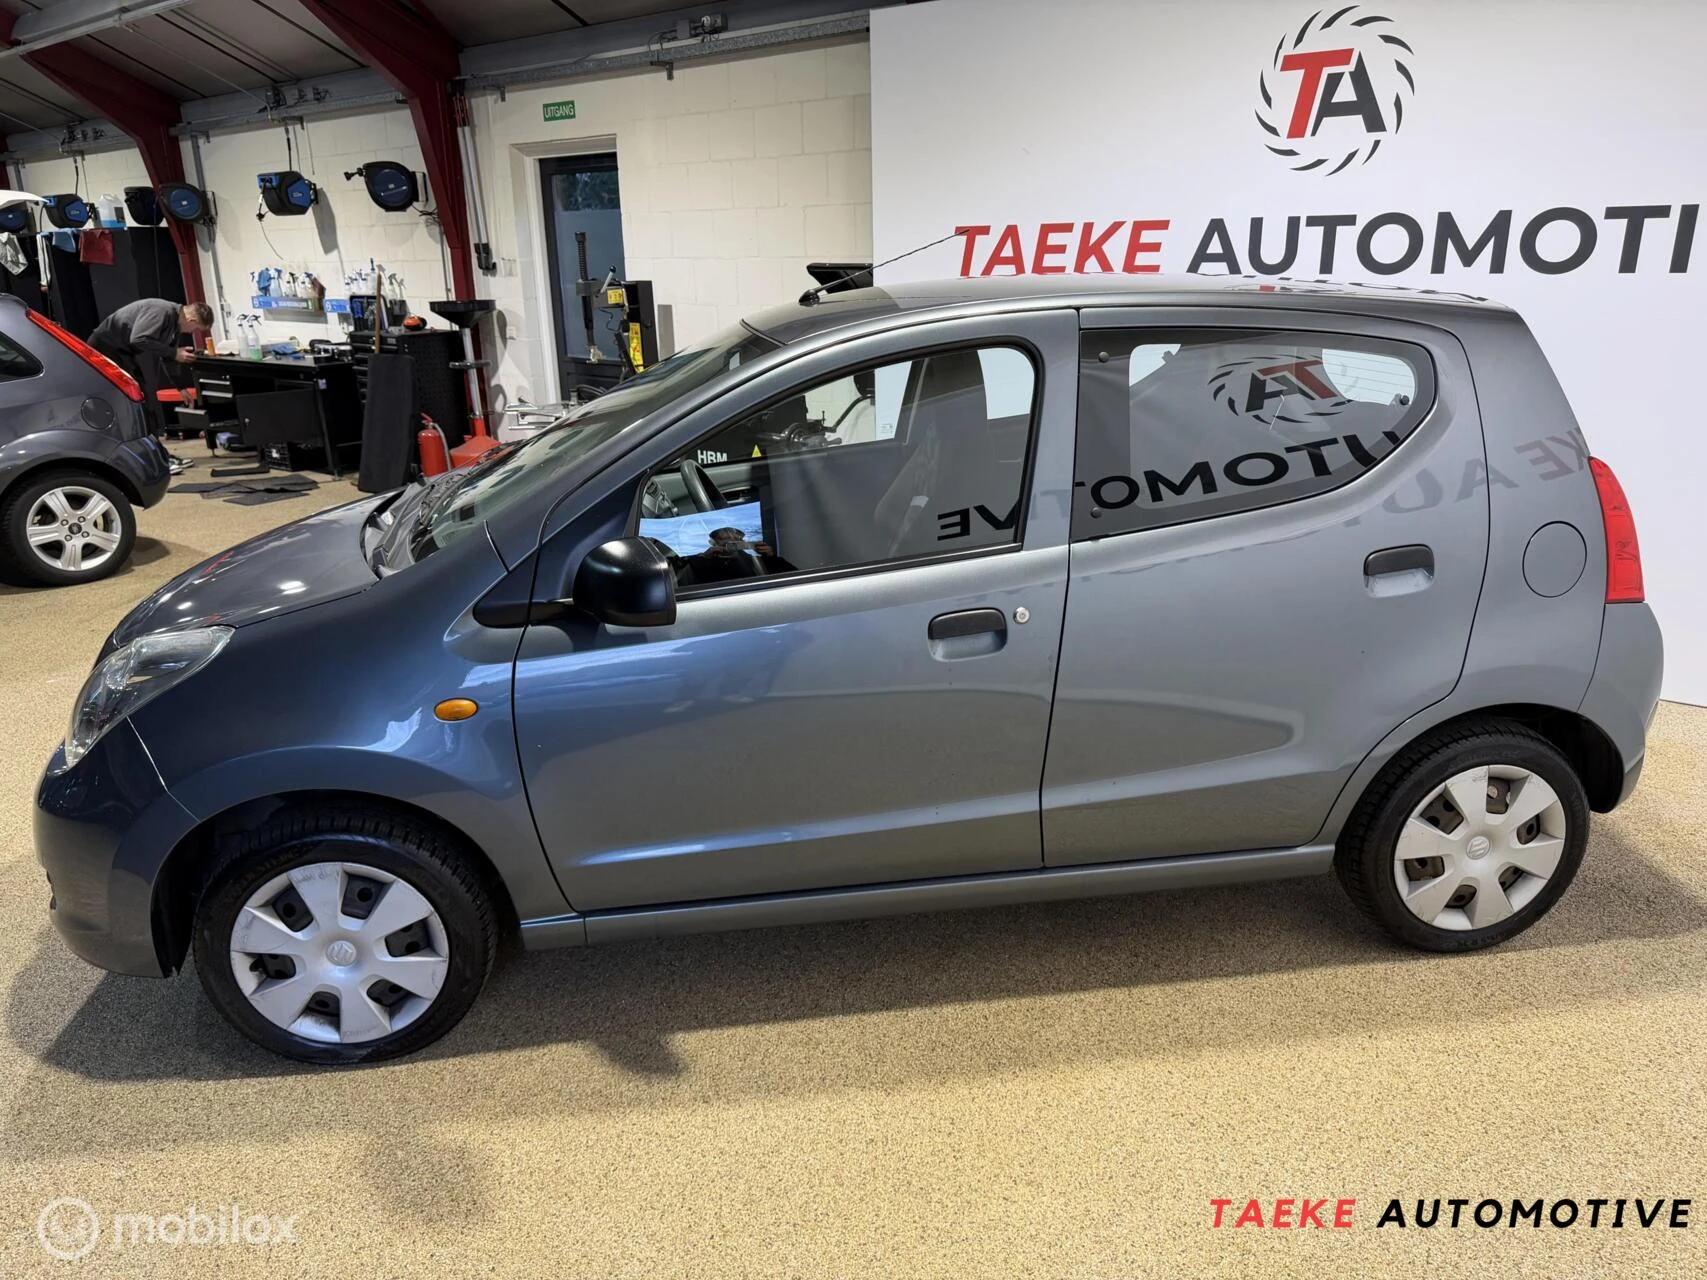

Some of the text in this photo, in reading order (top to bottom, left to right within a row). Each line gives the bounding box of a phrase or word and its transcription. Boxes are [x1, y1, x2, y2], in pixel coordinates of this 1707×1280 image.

[544, 104, 574, 118] UITGANG
[1280, 48, 1387, 139] TA
[954, 203, 1700, 277] TAEKE AUTOMOTI
